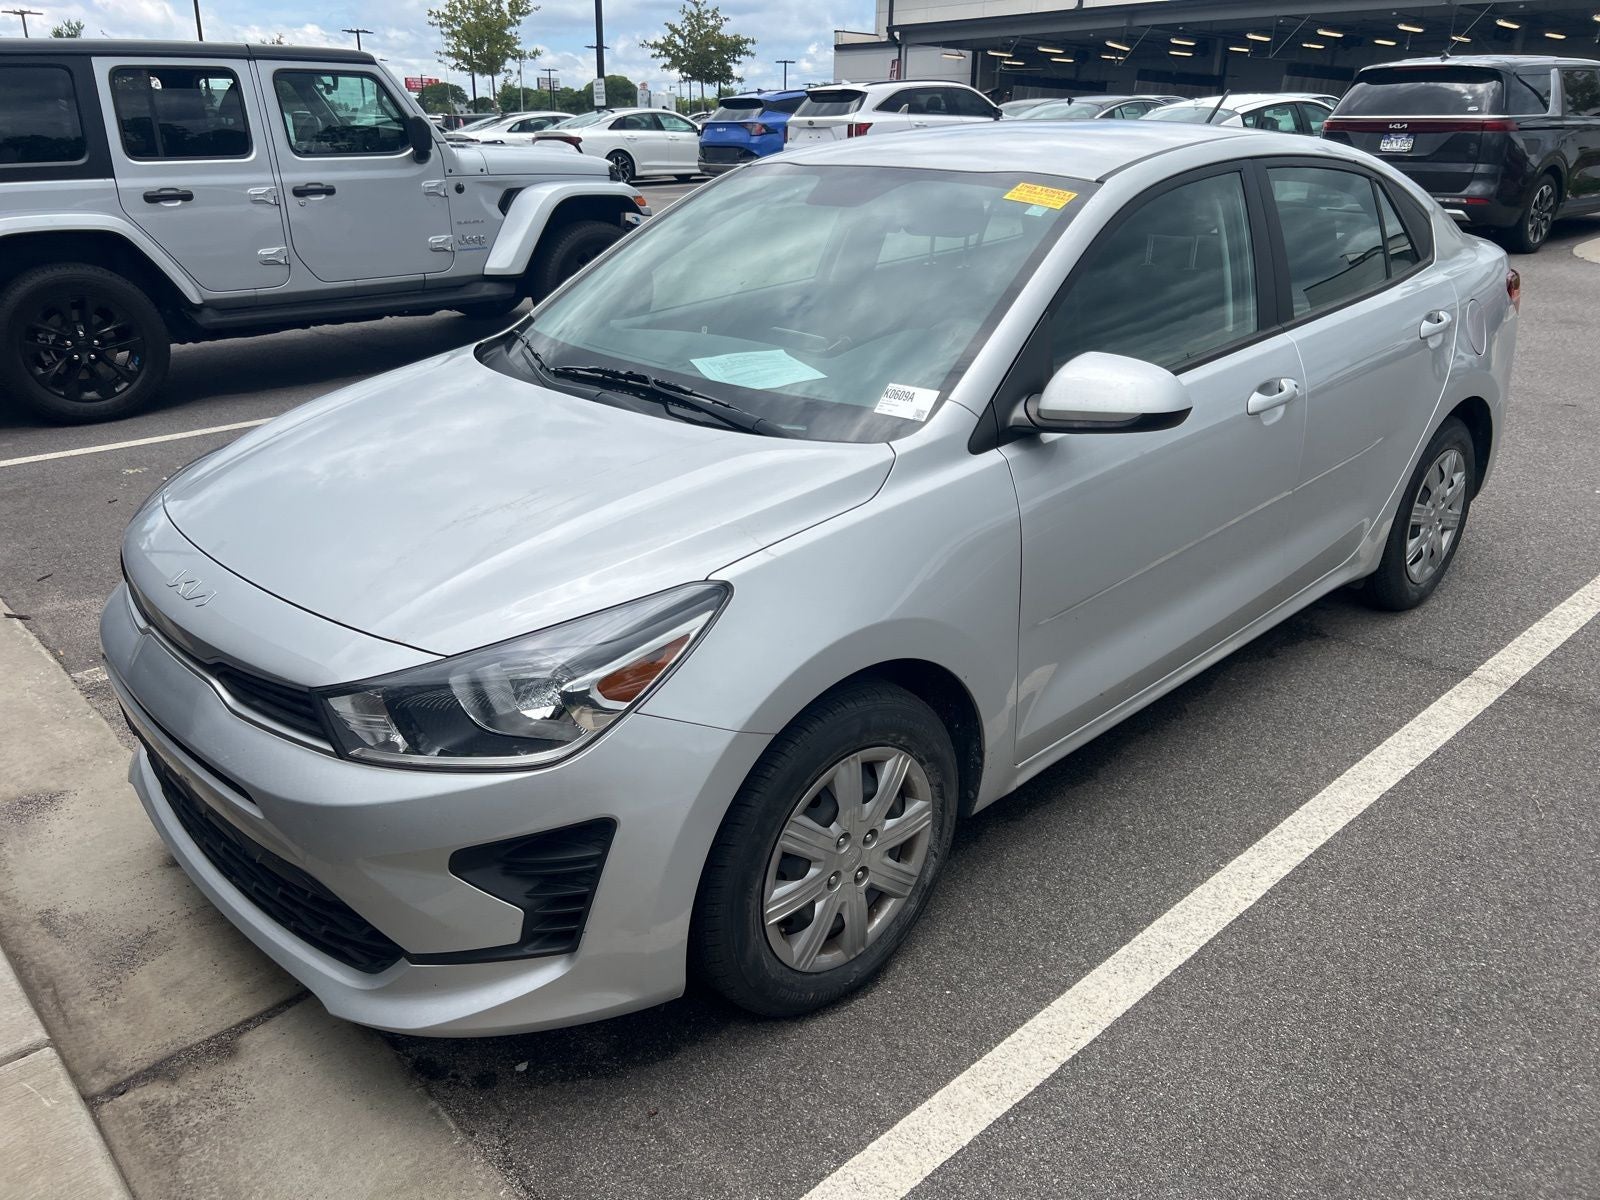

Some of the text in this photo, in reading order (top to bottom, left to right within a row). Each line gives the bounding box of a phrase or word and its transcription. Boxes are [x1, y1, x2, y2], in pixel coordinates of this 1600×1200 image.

[458, 233, 486, 246] Jeep
[883, 388, 916, 403] K0609A
[166, 569, 217, 607] KIA
